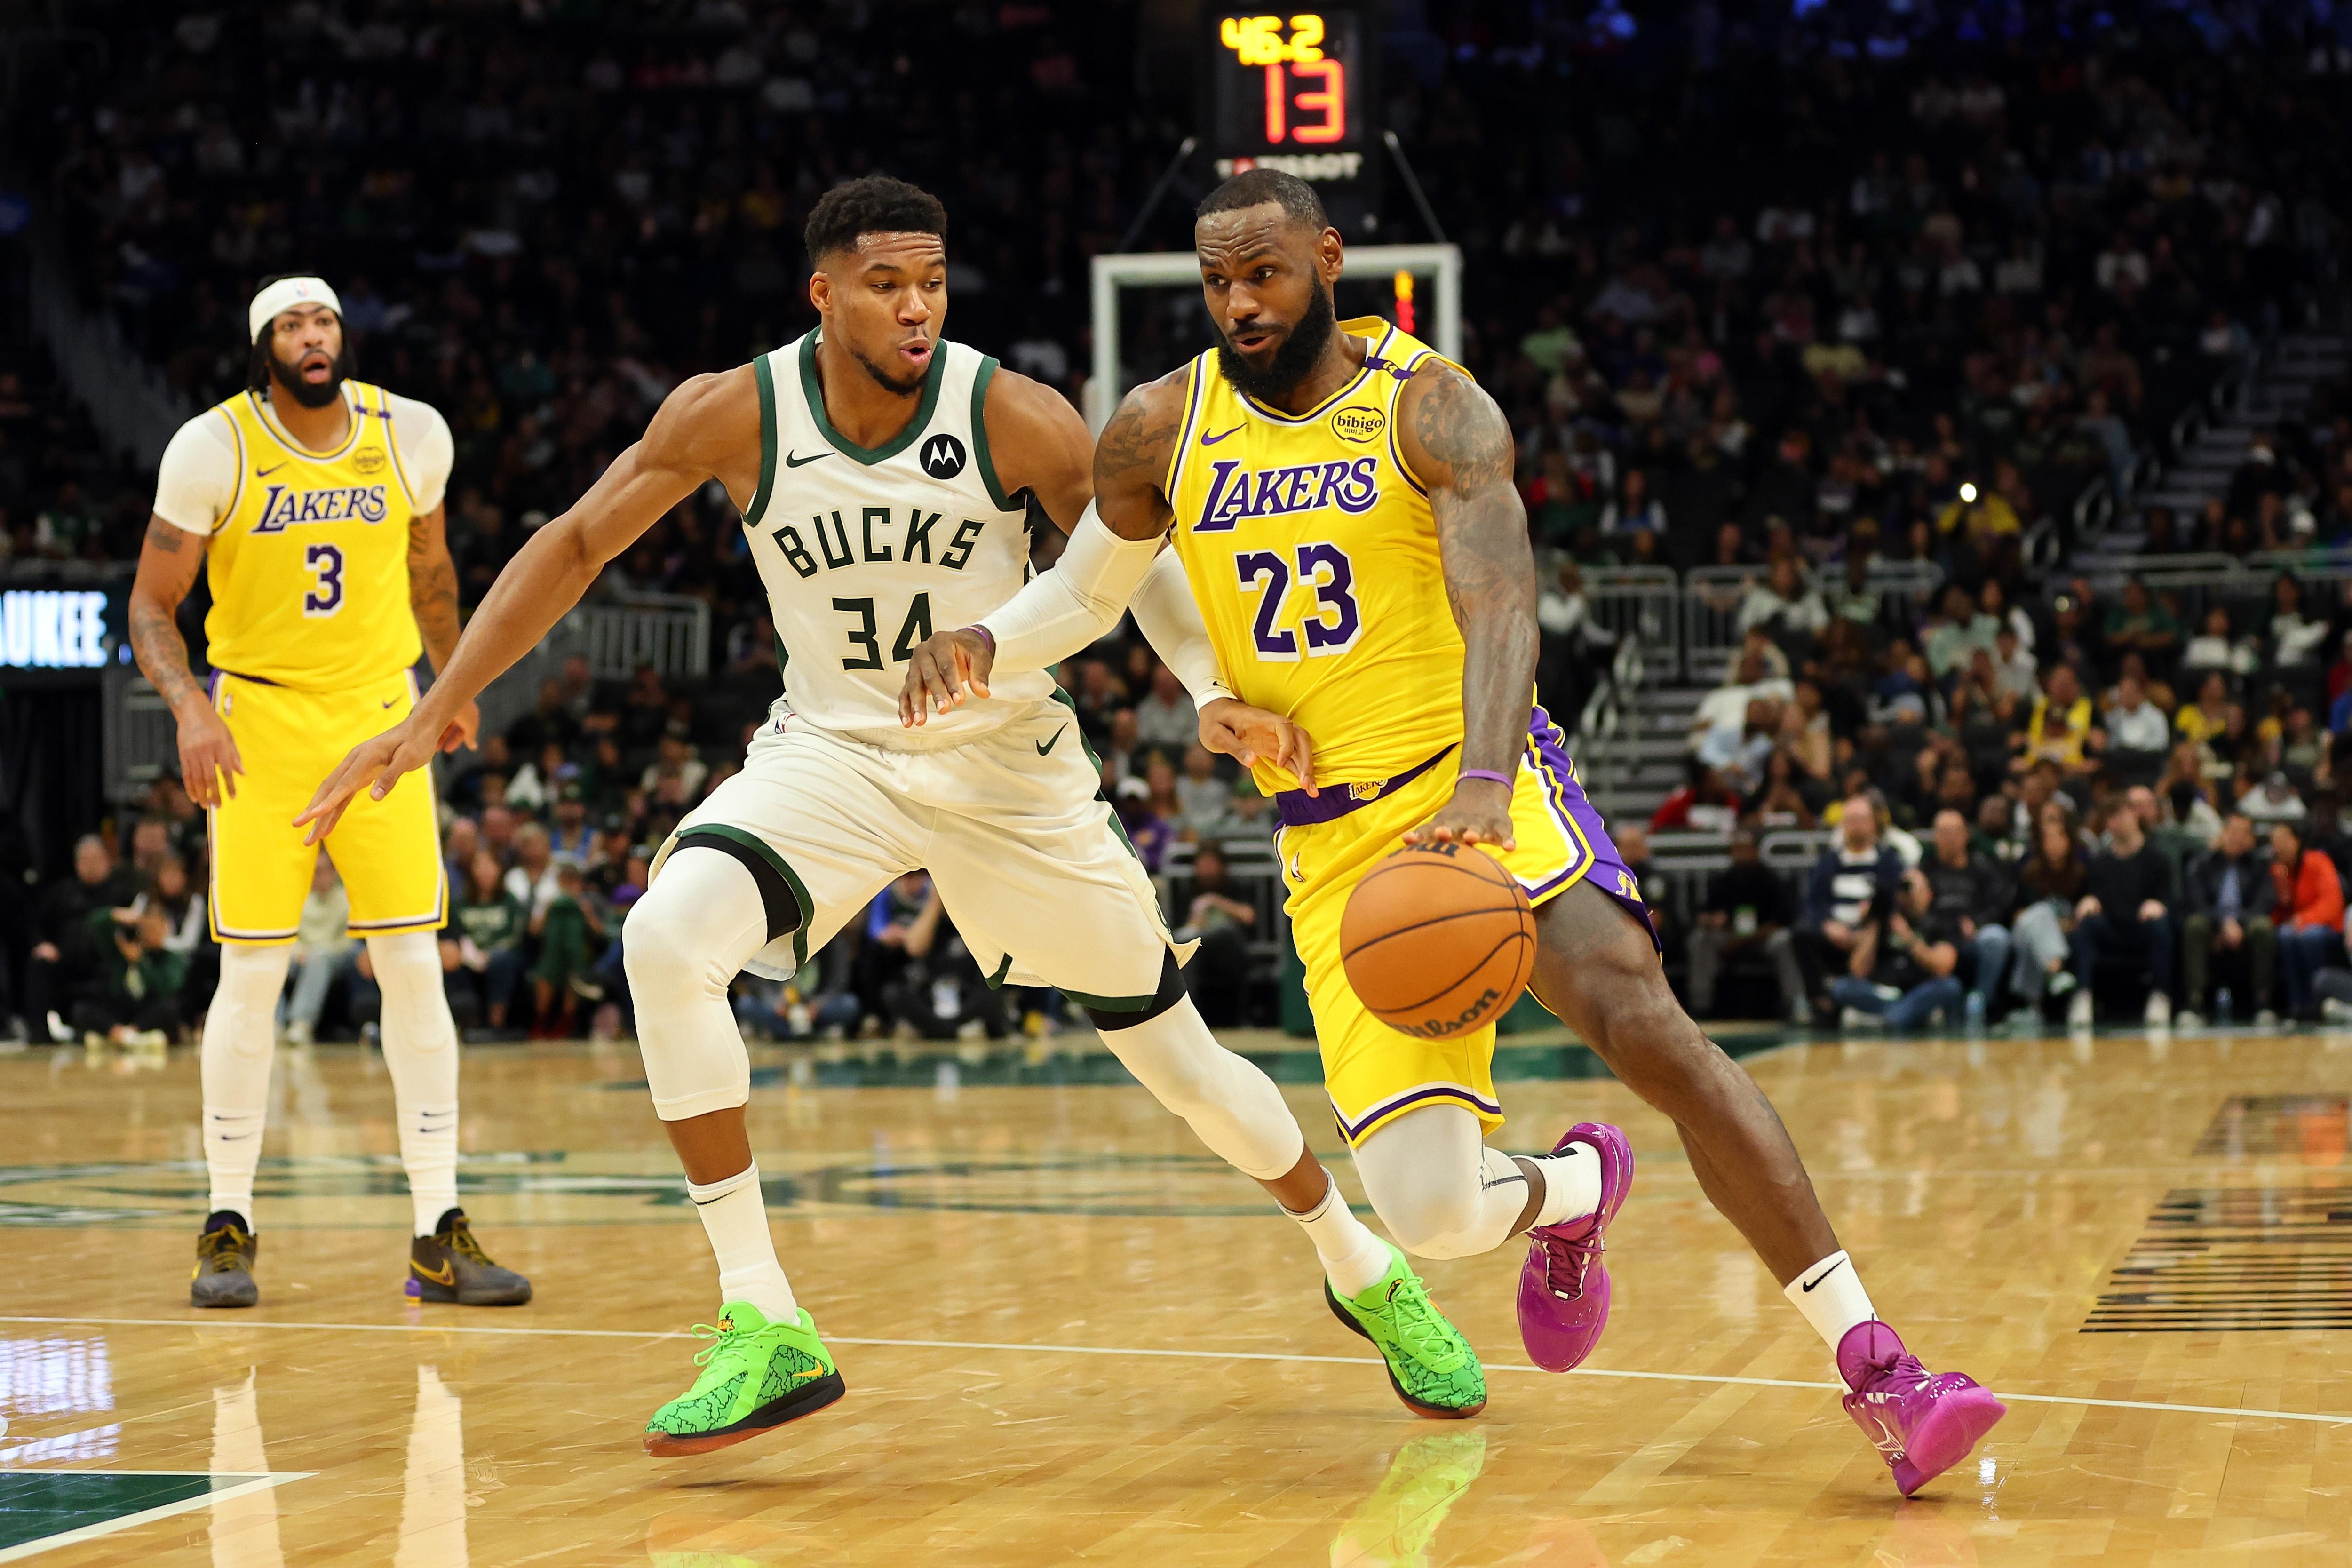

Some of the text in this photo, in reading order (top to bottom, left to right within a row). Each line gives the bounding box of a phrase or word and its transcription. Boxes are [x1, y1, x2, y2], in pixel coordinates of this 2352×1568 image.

[1265, 59, 1345, 144] 13
[1337, 415, 1383, 432] bibigo
[252, 485, 386, 534] LAKERS
[1192, 456, 1380, 533] LAKERS
[304, 544, 343, 617] 3
[771, 506, 986, 579] BUCKS
[0, 590, 108, 668] UKEE
[831, 591, 934, 671] 34
[1234, 541, 1362, 661] 23
